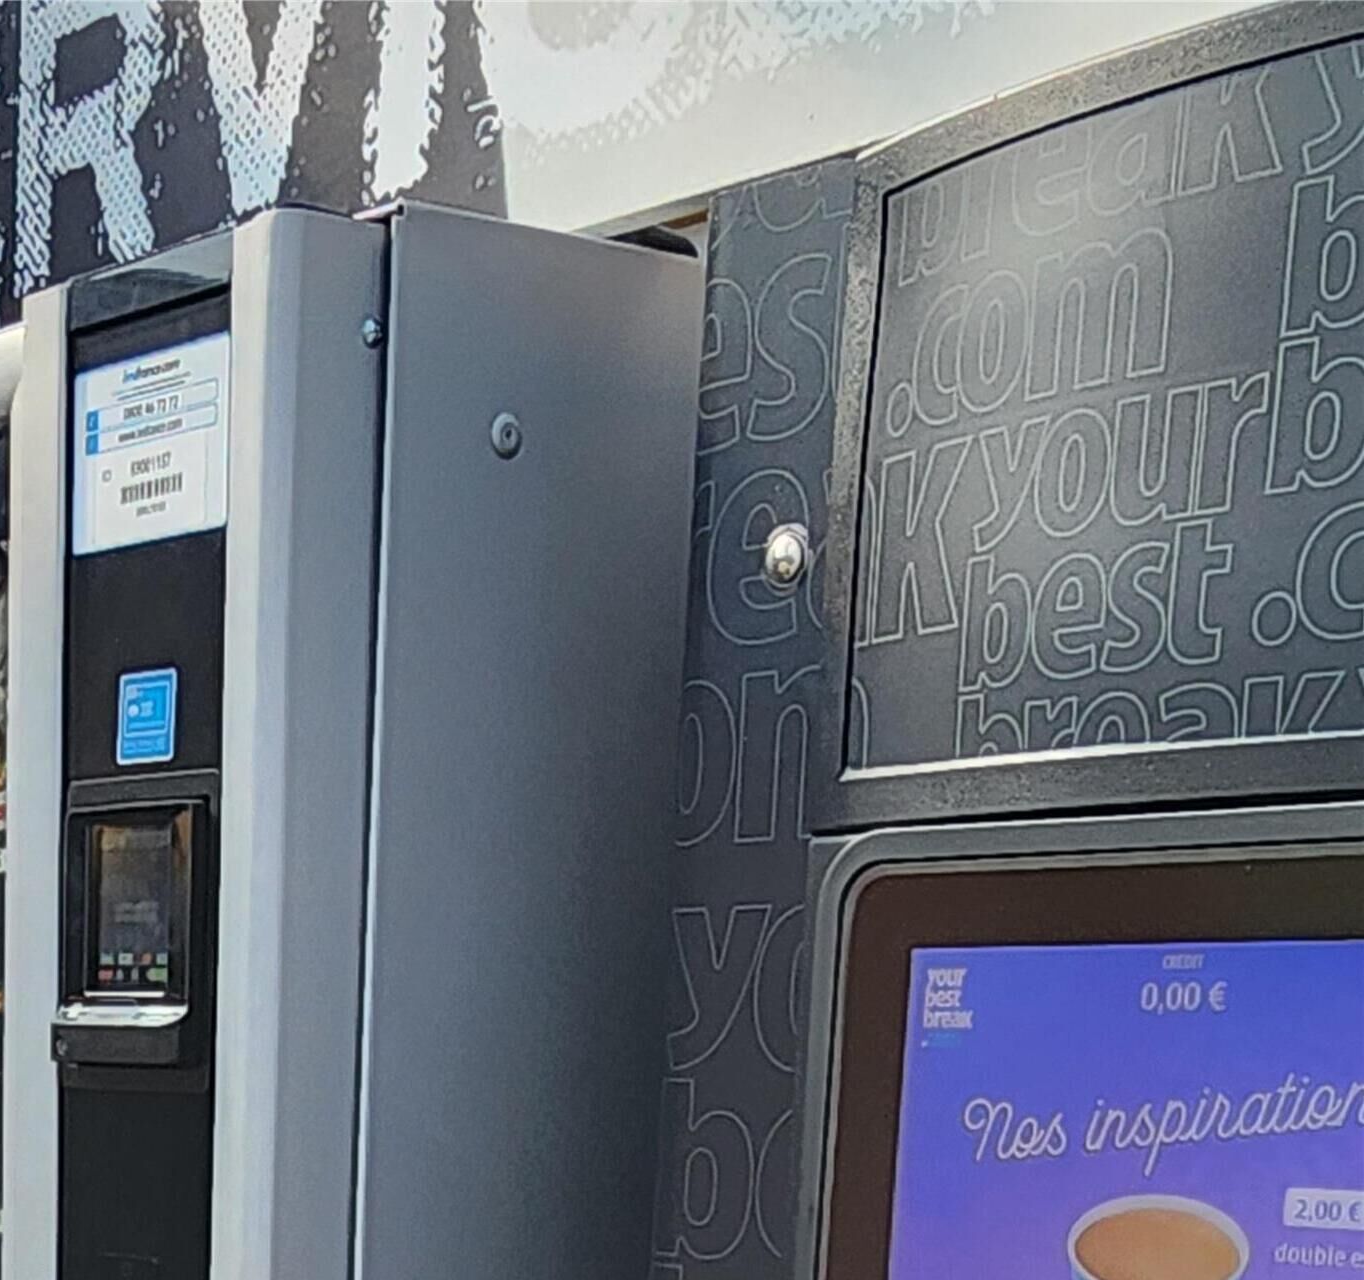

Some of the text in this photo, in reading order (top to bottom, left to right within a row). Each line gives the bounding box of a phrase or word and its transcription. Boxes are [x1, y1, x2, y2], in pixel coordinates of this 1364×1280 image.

[957, 516, 1236, 694] best
[1140, 981, 1229, 1014] 0,00 €
[963, 1071, 1364, 1177] Nos inspiration
[1294, 1198, 1364, 1223] 2,00 €
[1274, 1241, 1347, 1267] double
